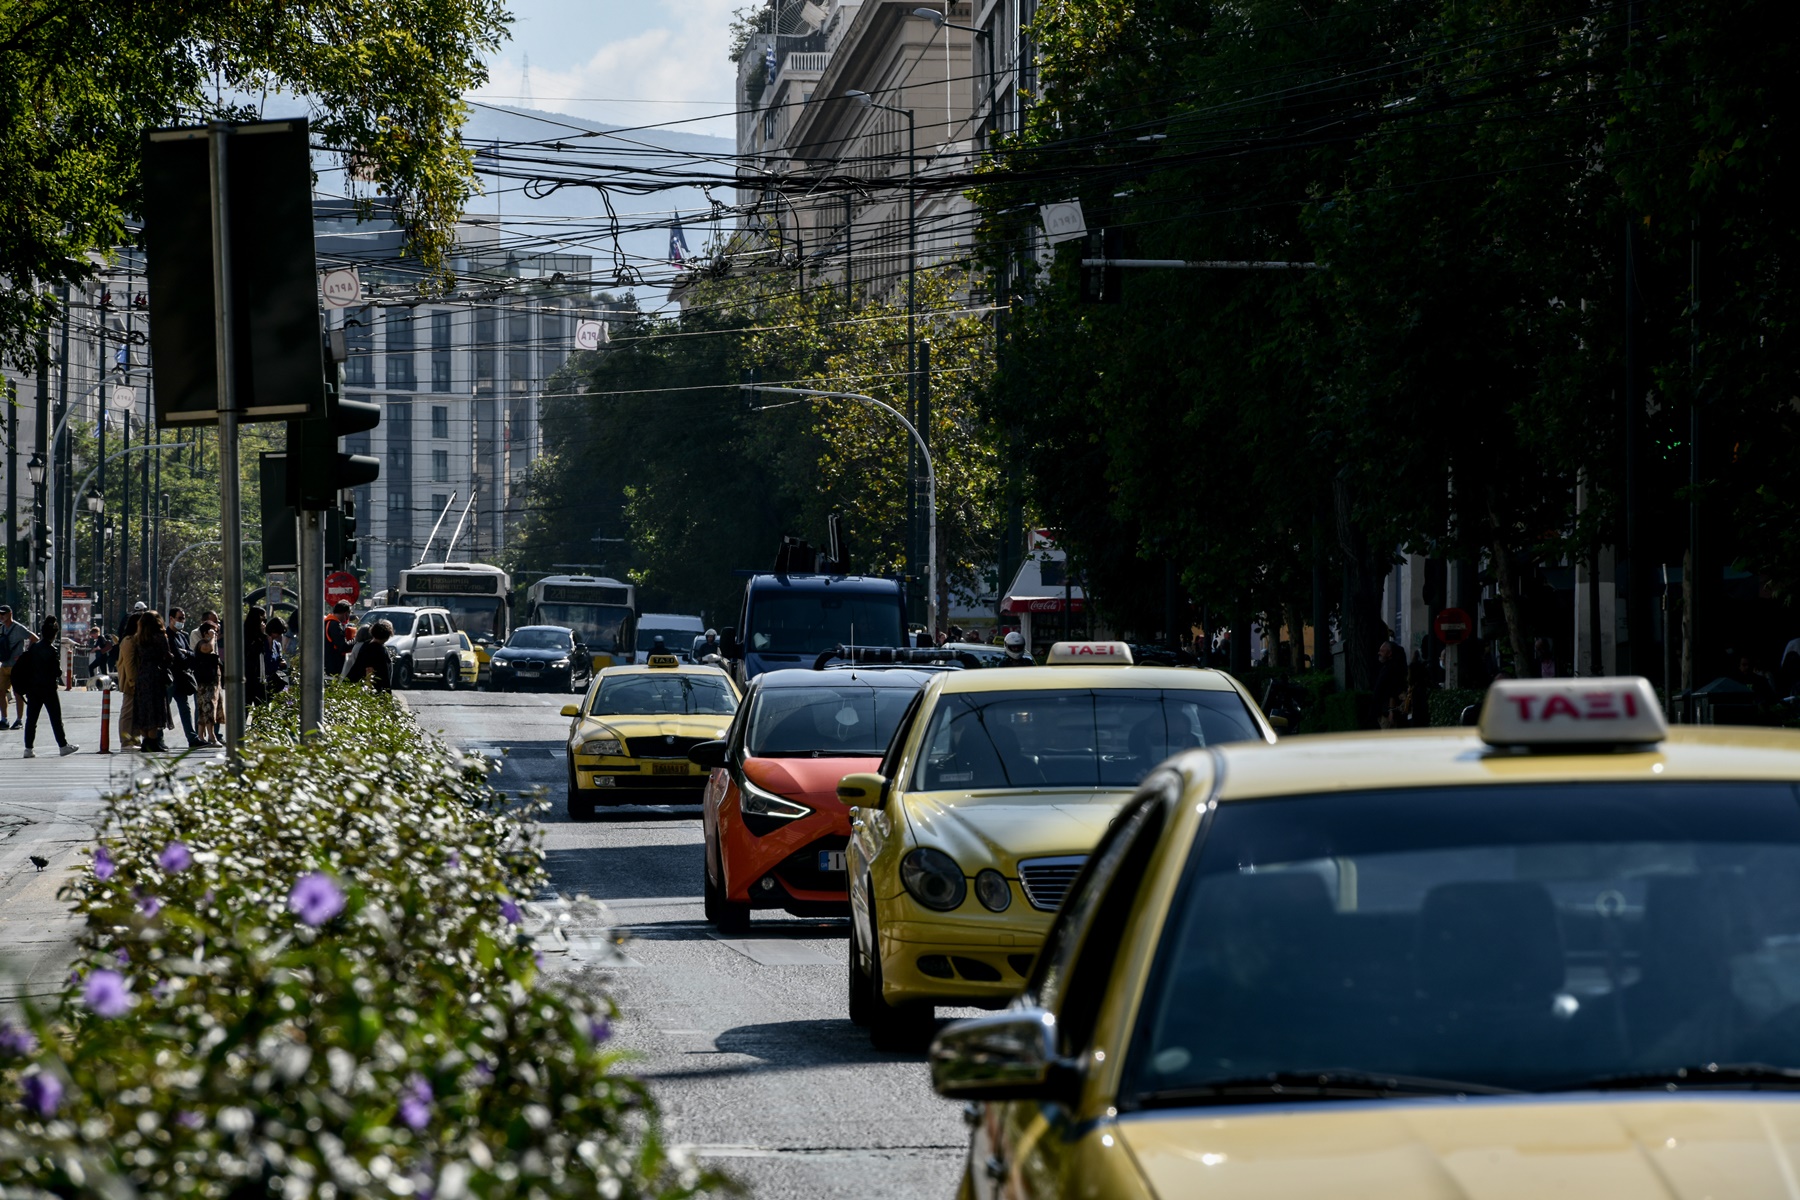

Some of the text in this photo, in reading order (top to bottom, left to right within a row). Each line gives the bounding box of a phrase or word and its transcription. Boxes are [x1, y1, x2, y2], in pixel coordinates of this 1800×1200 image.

[416, 577, 432, 590] 221
[550, 588, 566, 599] 220
[1031, 600, 1057, 610] Coca-Cola
[1068, 645, 1115, 655] ΤΑΞΙ
[1507, 690, 1639, 722] ΤΑΞΙ
